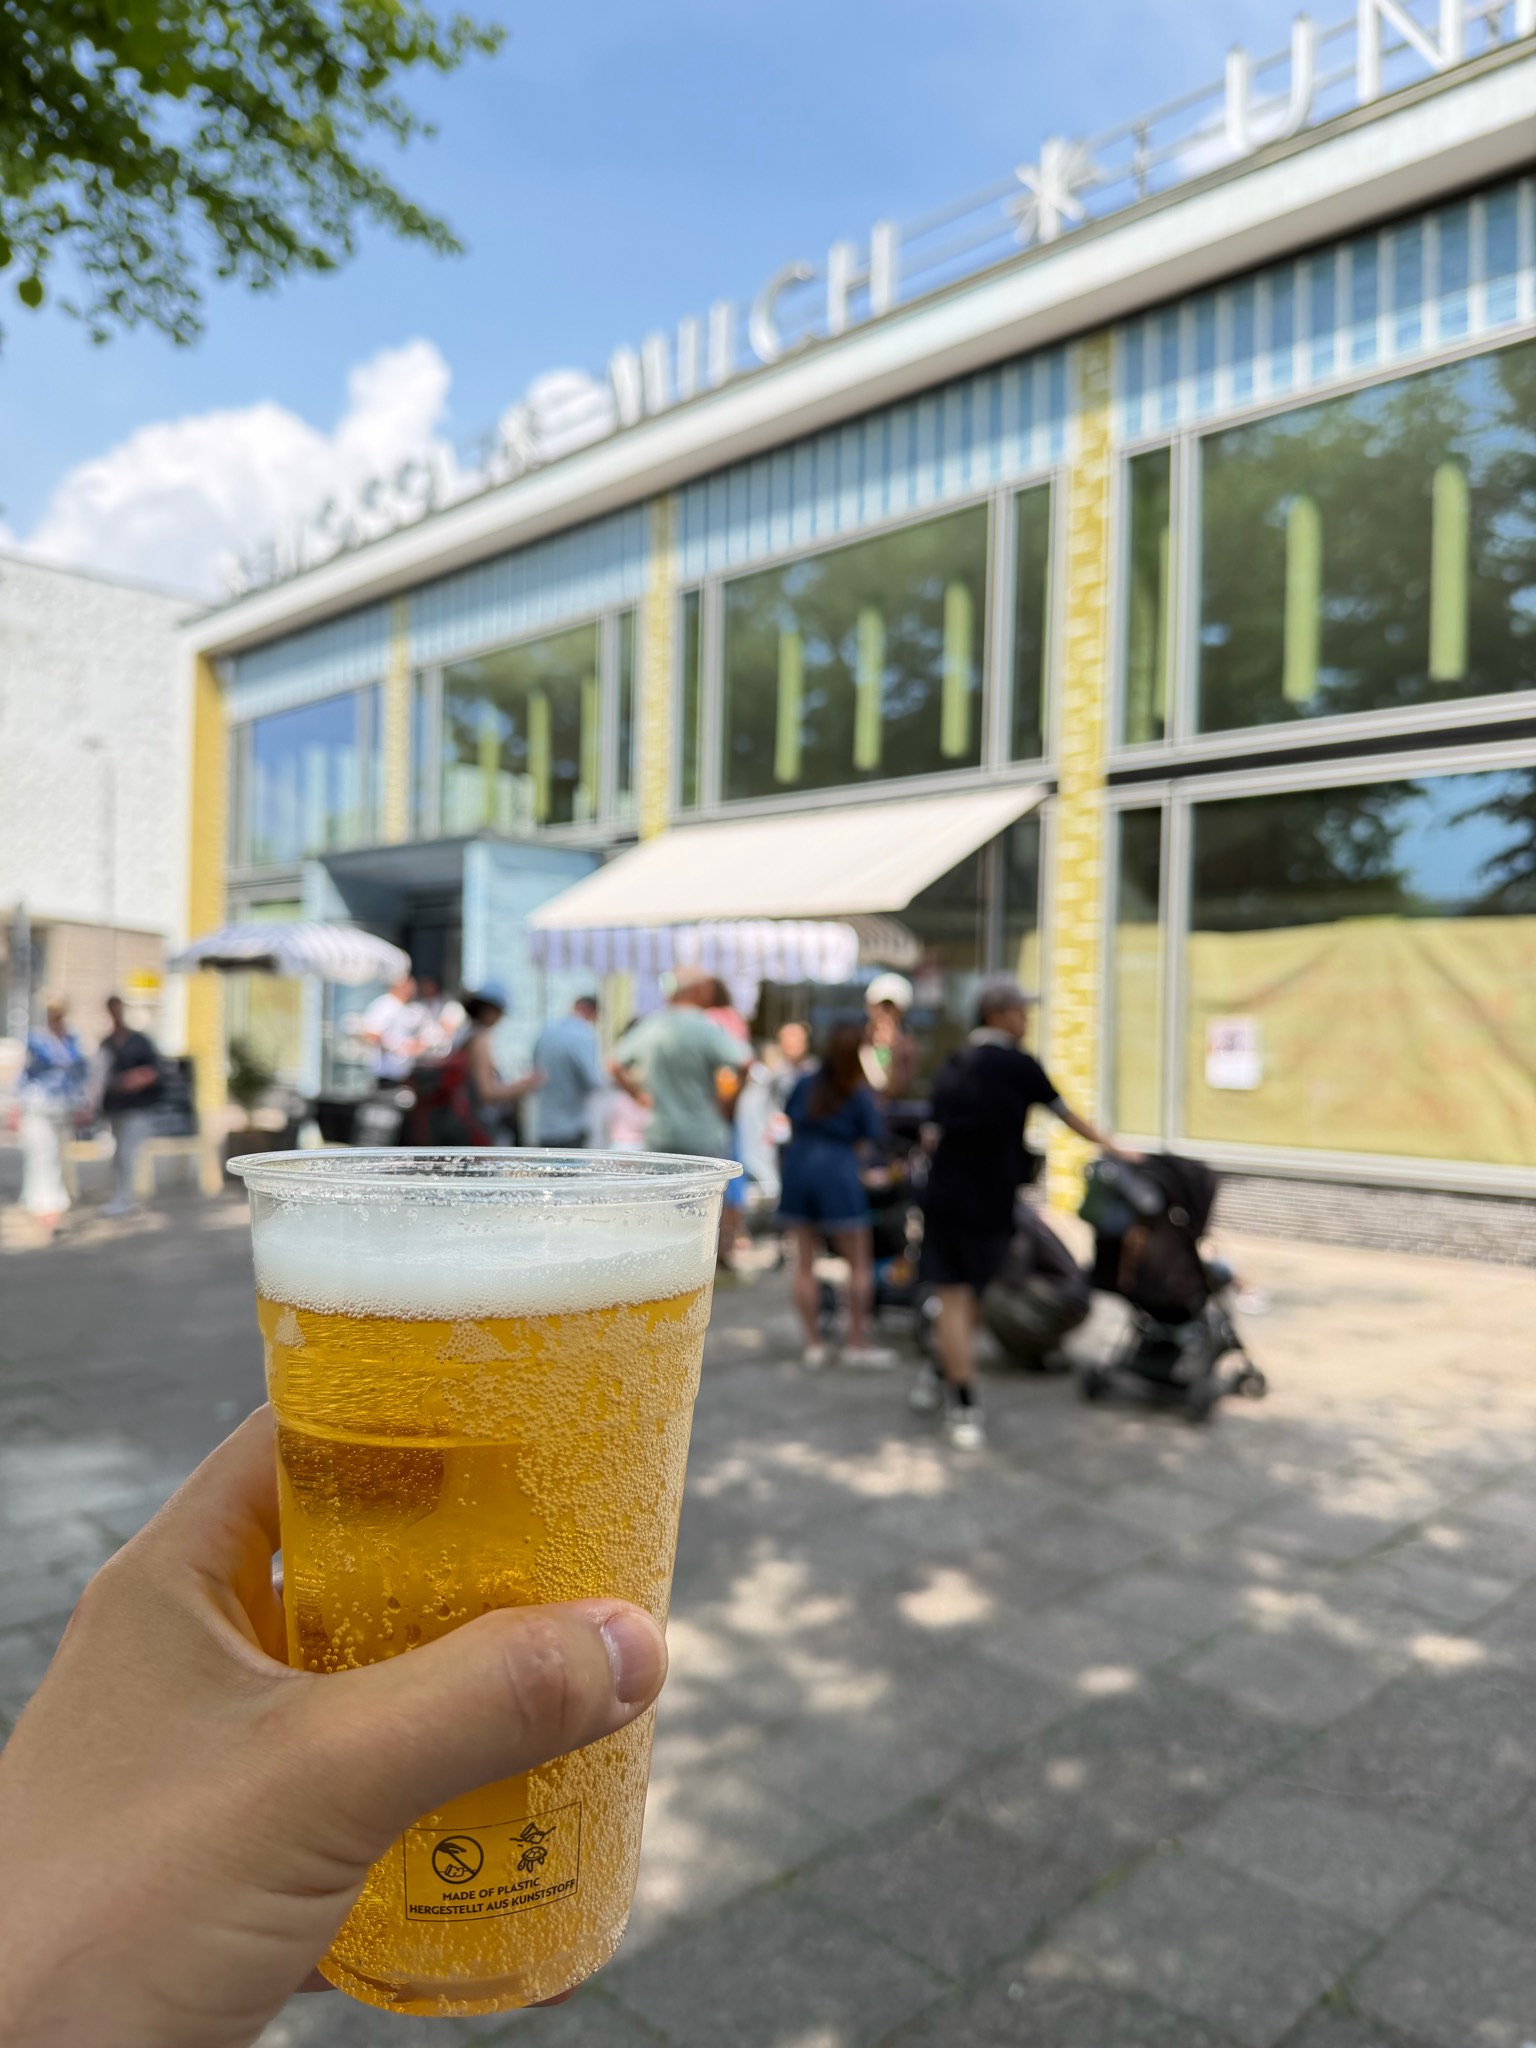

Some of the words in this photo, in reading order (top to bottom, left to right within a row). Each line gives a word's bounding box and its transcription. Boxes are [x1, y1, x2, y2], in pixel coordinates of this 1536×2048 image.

[1224, 0, 1536, 152] UN
[409, 1903, 484, 1915] HERGESTELLT
[486, 1898, 509, 1912] AUS
[511, 1879, 576, 1907] KUNSTSTOFF
[443, 1890, 476, 1901] MADE
[478, 1888, 495, 1898] OF
[497, 1877, 540, 1896] PLASTIC
